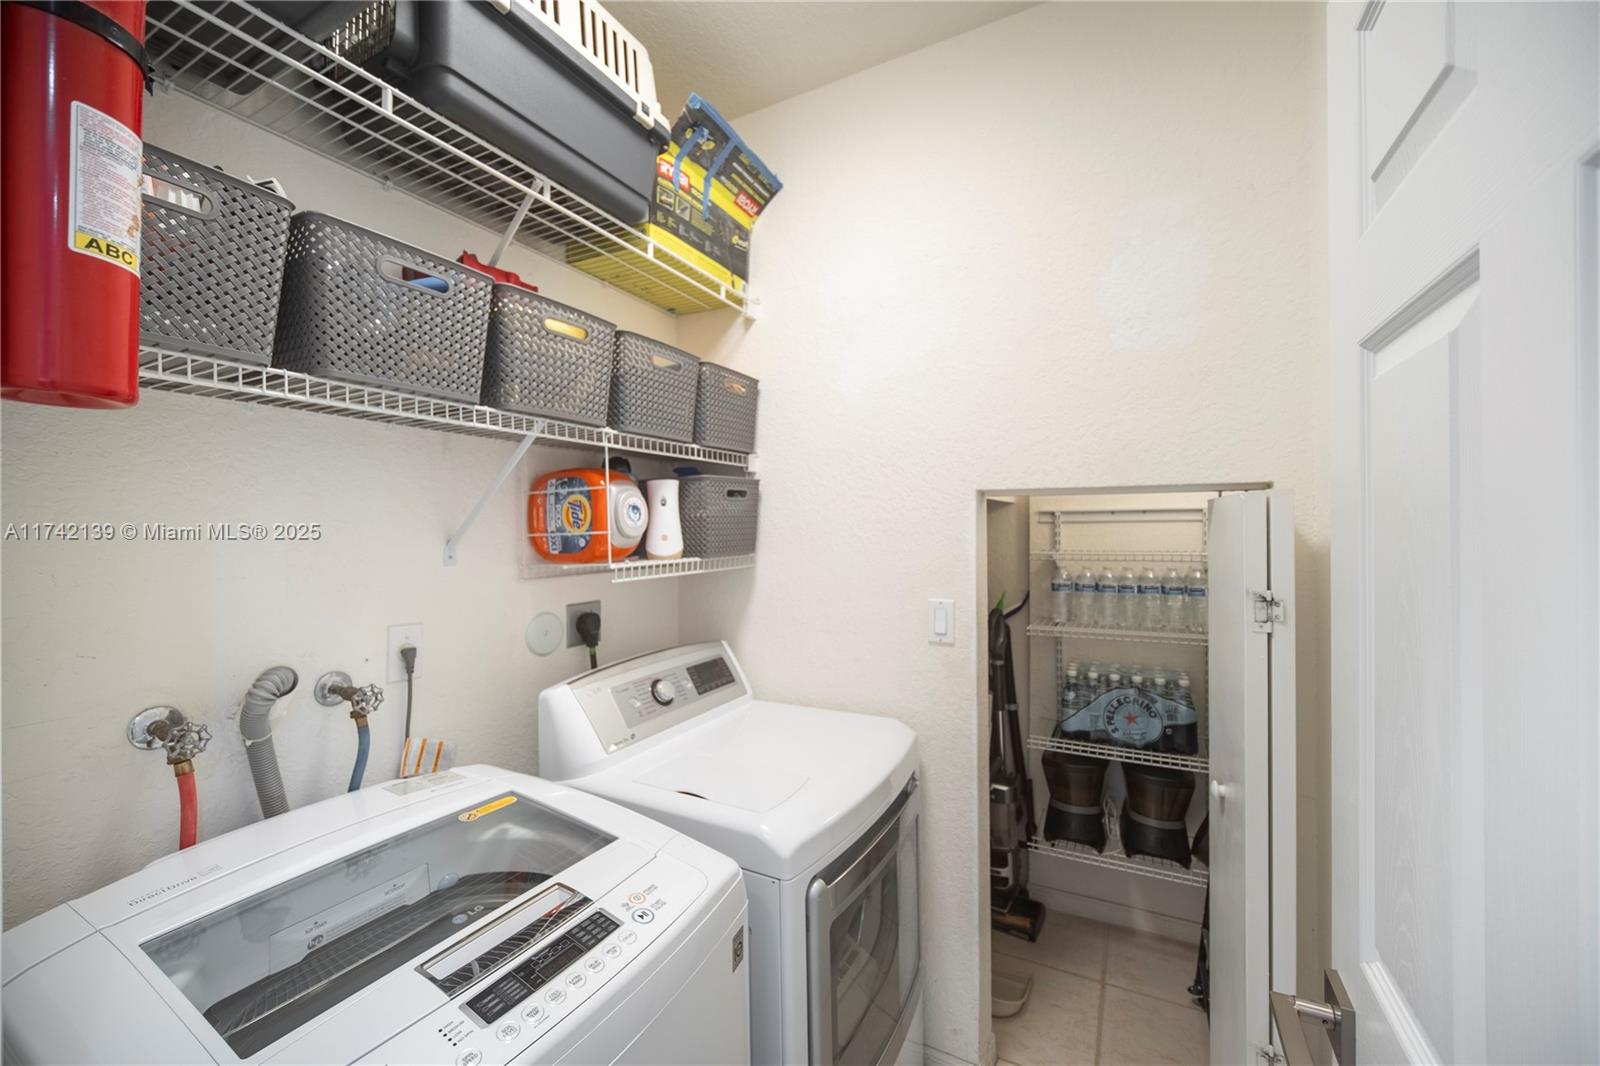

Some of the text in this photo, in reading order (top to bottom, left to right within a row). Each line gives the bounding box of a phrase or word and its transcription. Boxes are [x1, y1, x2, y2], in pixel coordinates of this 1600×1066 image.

[660, 162, 689, 187] RYBI
[84, 237, 134, 266] ABC
[567, 499, 583, 529] Tide
[468, 904, 485, 917] LG
